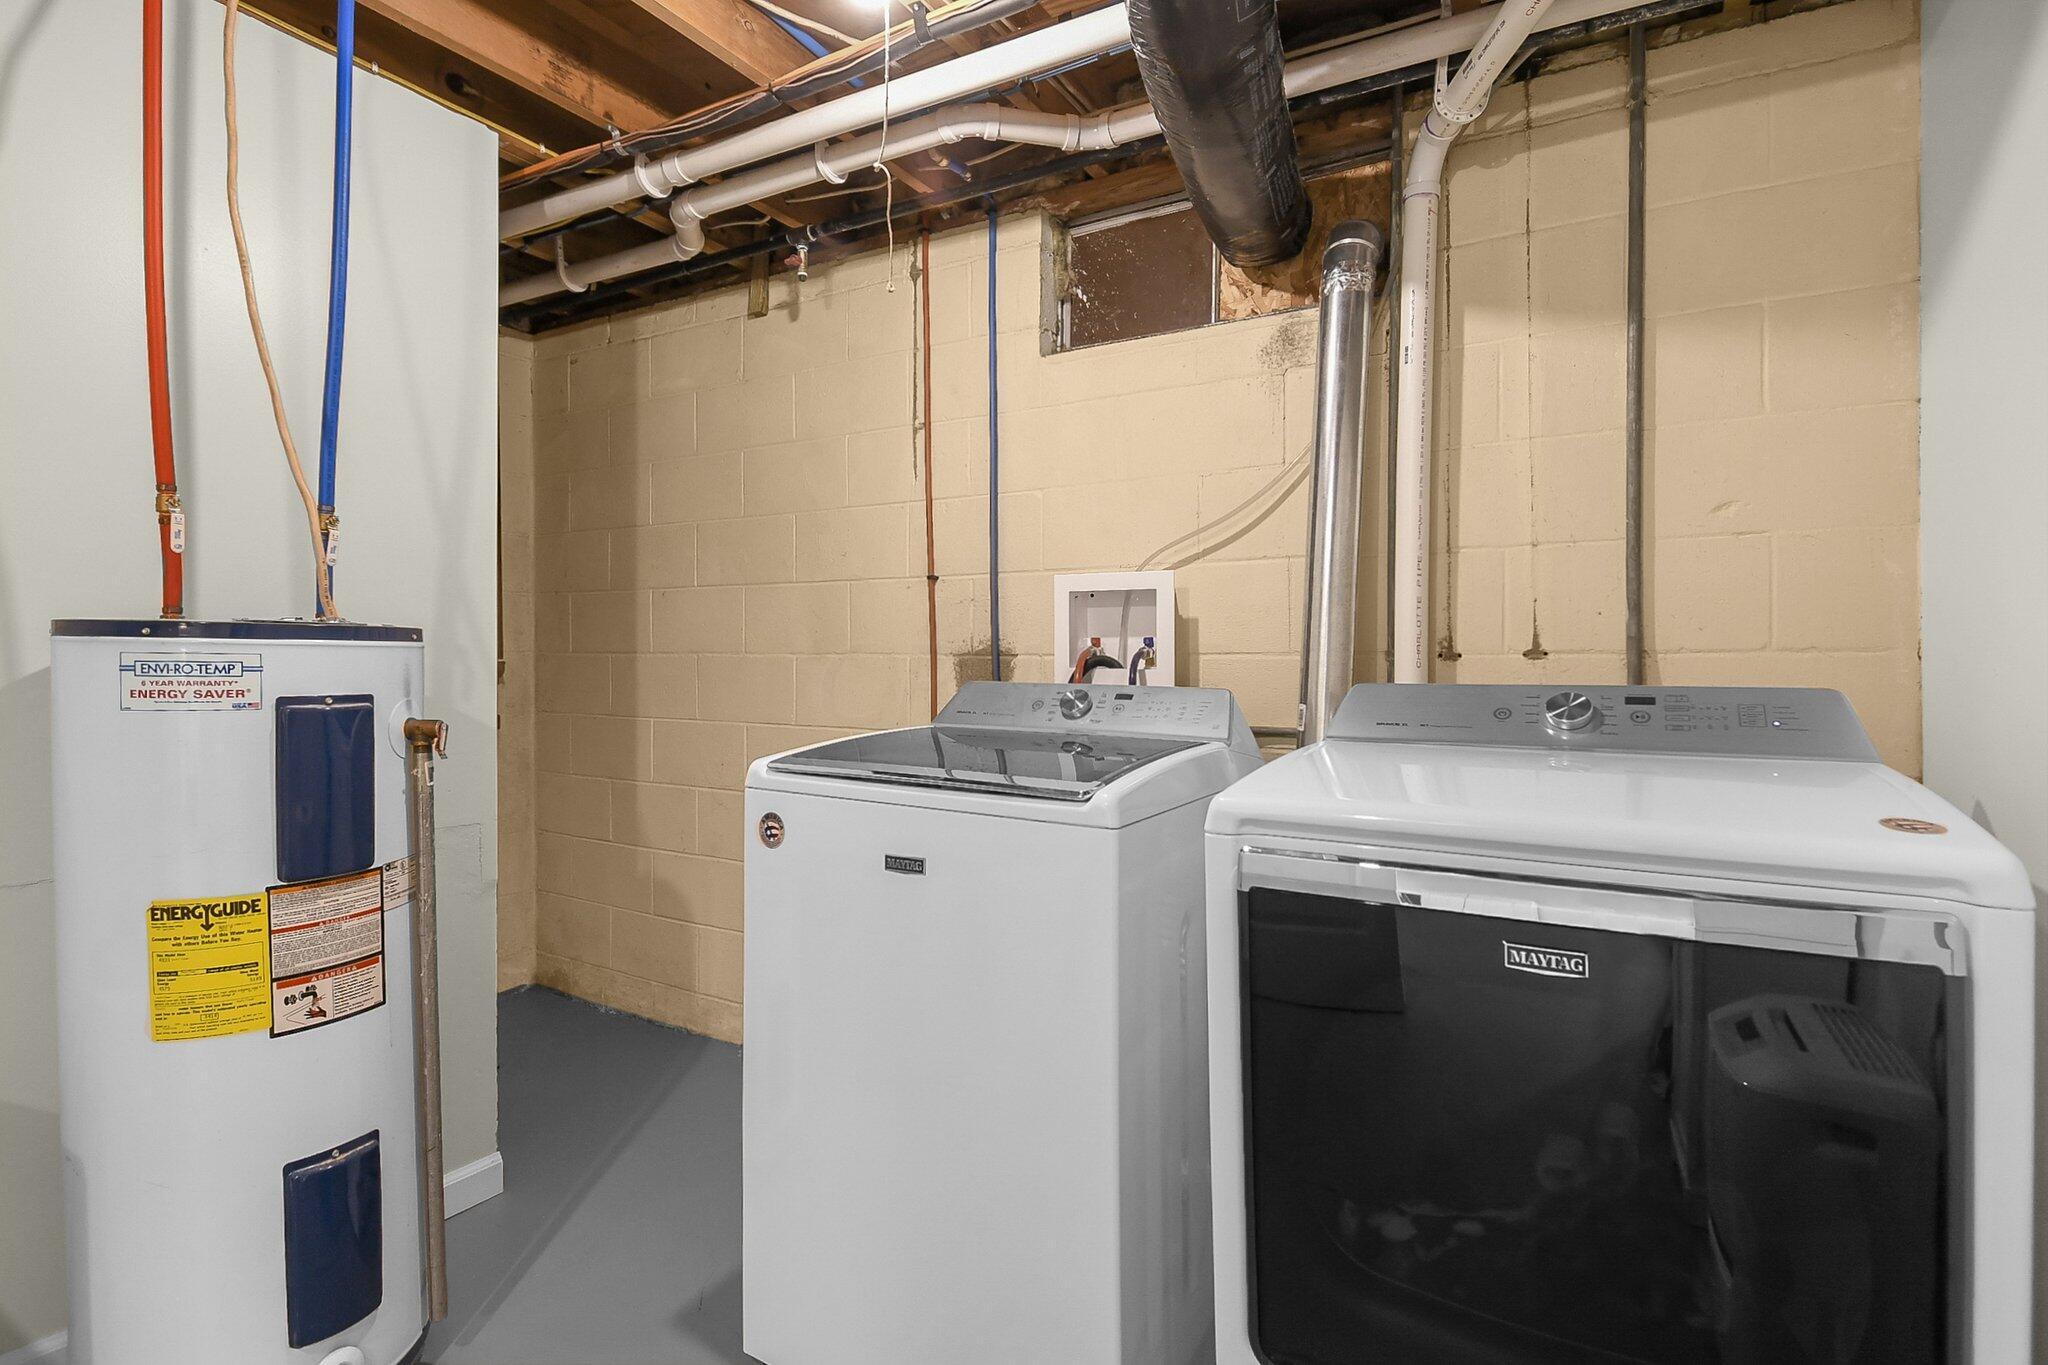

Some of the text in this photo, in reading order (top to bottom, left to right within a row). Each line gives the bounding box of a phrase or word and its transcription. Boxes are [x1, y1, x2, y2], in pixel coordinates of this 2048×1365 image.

[140, 663, 236, 675] ENVI-RO-TEMP
[130, 689, 187, 699] ENERGY
[886, 858, 923, 871] MAYTAG
[151, 899, 262, 931] ENERGYGUIDE
[1509, 949, 1583, 972] MAYTAG
[319, 967, 352, 979] DANGER
